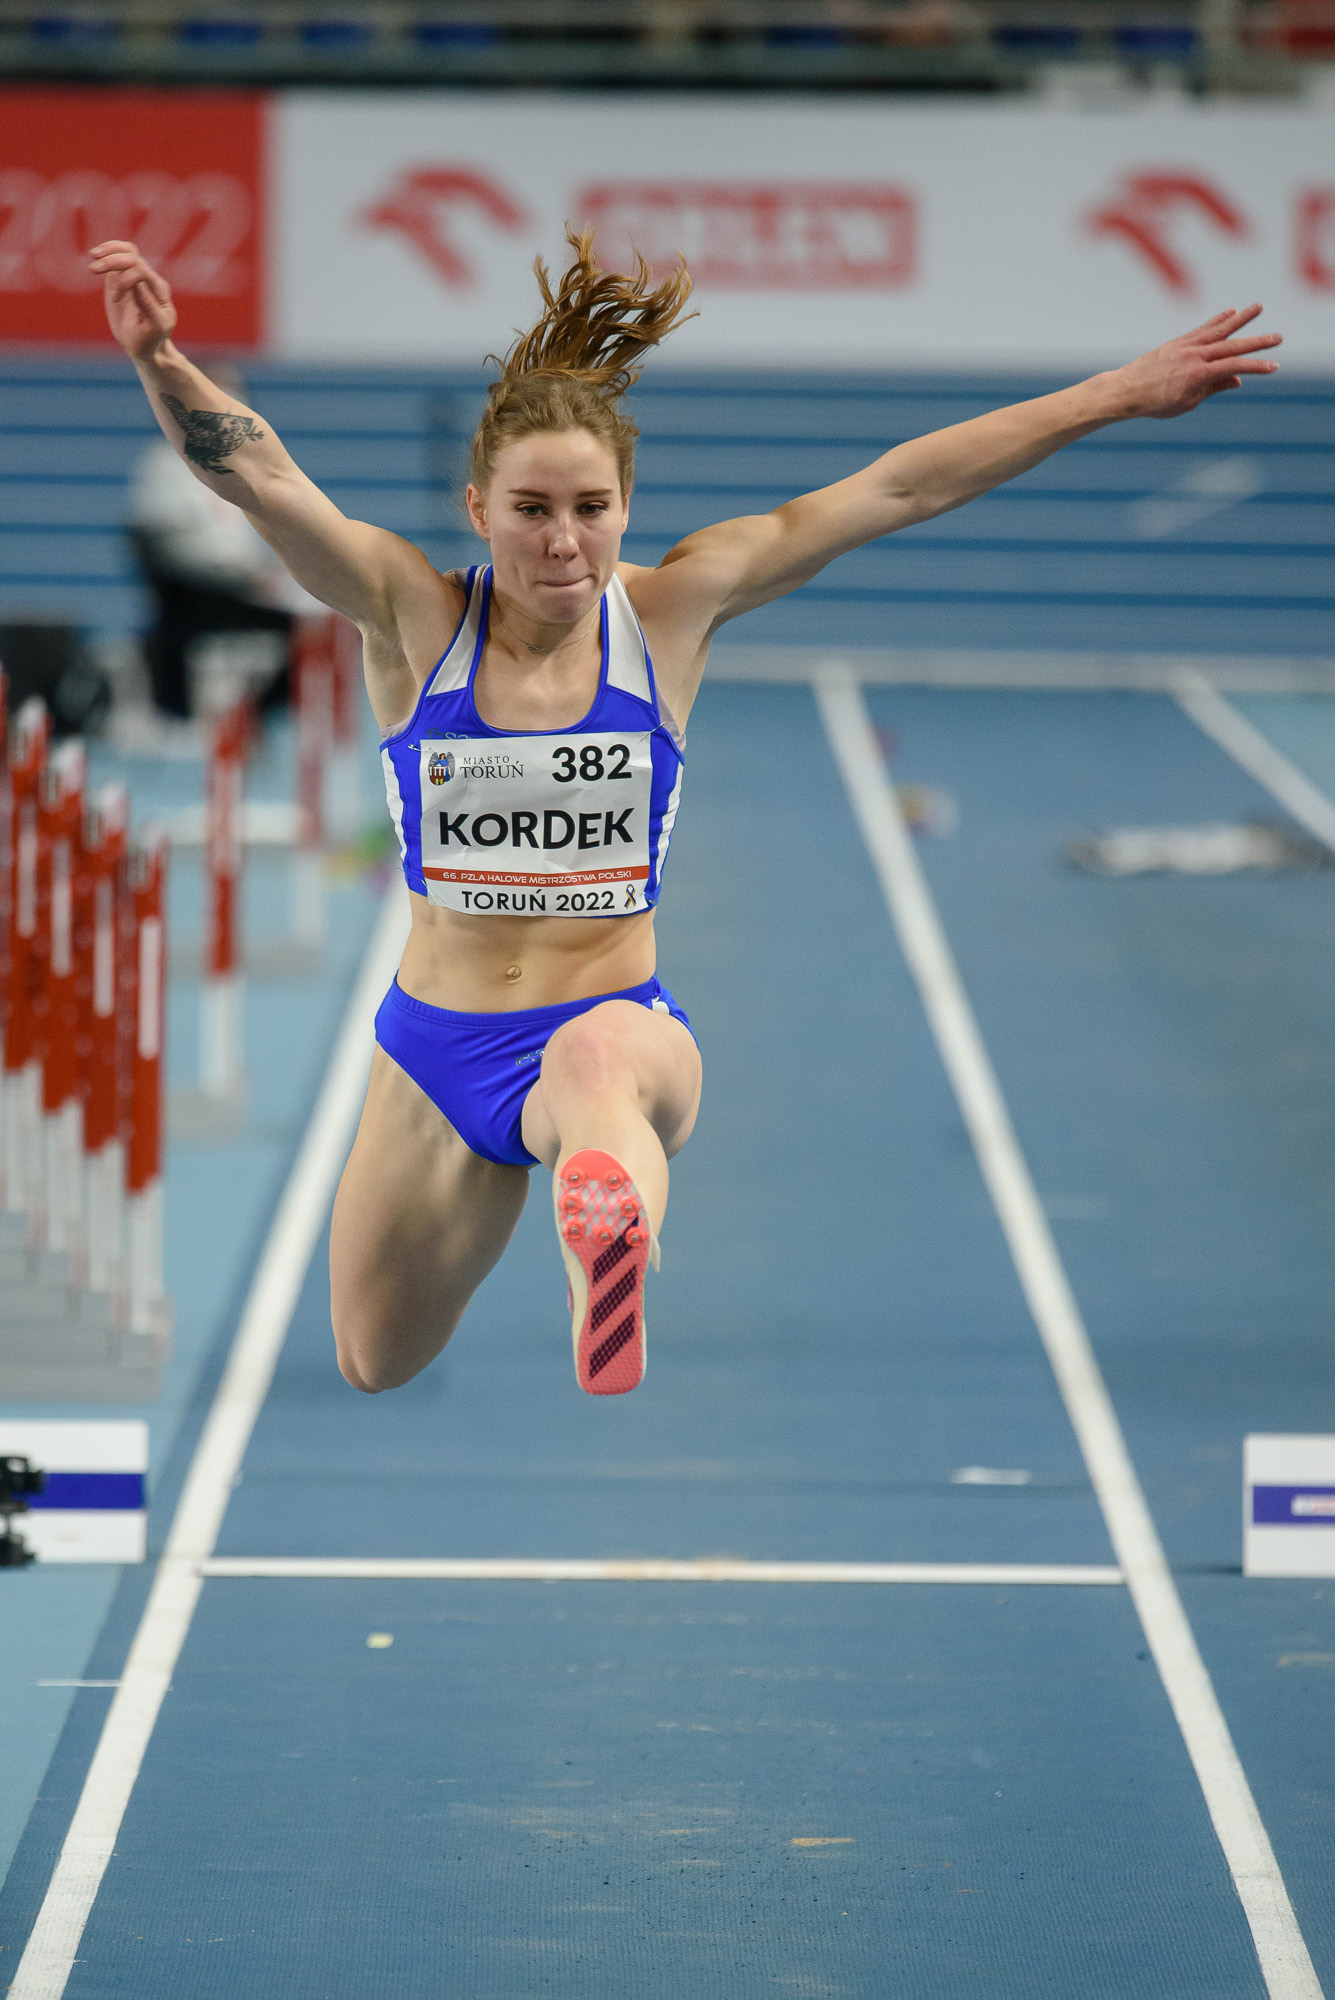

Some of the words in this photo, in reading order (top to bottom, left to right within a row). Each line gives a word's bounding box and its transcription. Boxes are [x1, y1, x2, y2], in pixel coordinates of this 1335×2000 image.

[460, 760, 525, 779] TORUŃ
[463, 755, 510, 765] MIASTO
[551, 743, 633, 783] 382
[438, 807, 636, 850] KORDEK
[442, 871, 459, 880] 66.
[461, 873, 486, 882] PZLA
[487, 875, 528, 884] HALOWE
[528, 873, 597, 885] MISTRZOSTWA
[598, 870, 632, 881] POLSKI
[461, 888, 547, 912] TORUŃ
[555, 890, 616, 912] 2022
